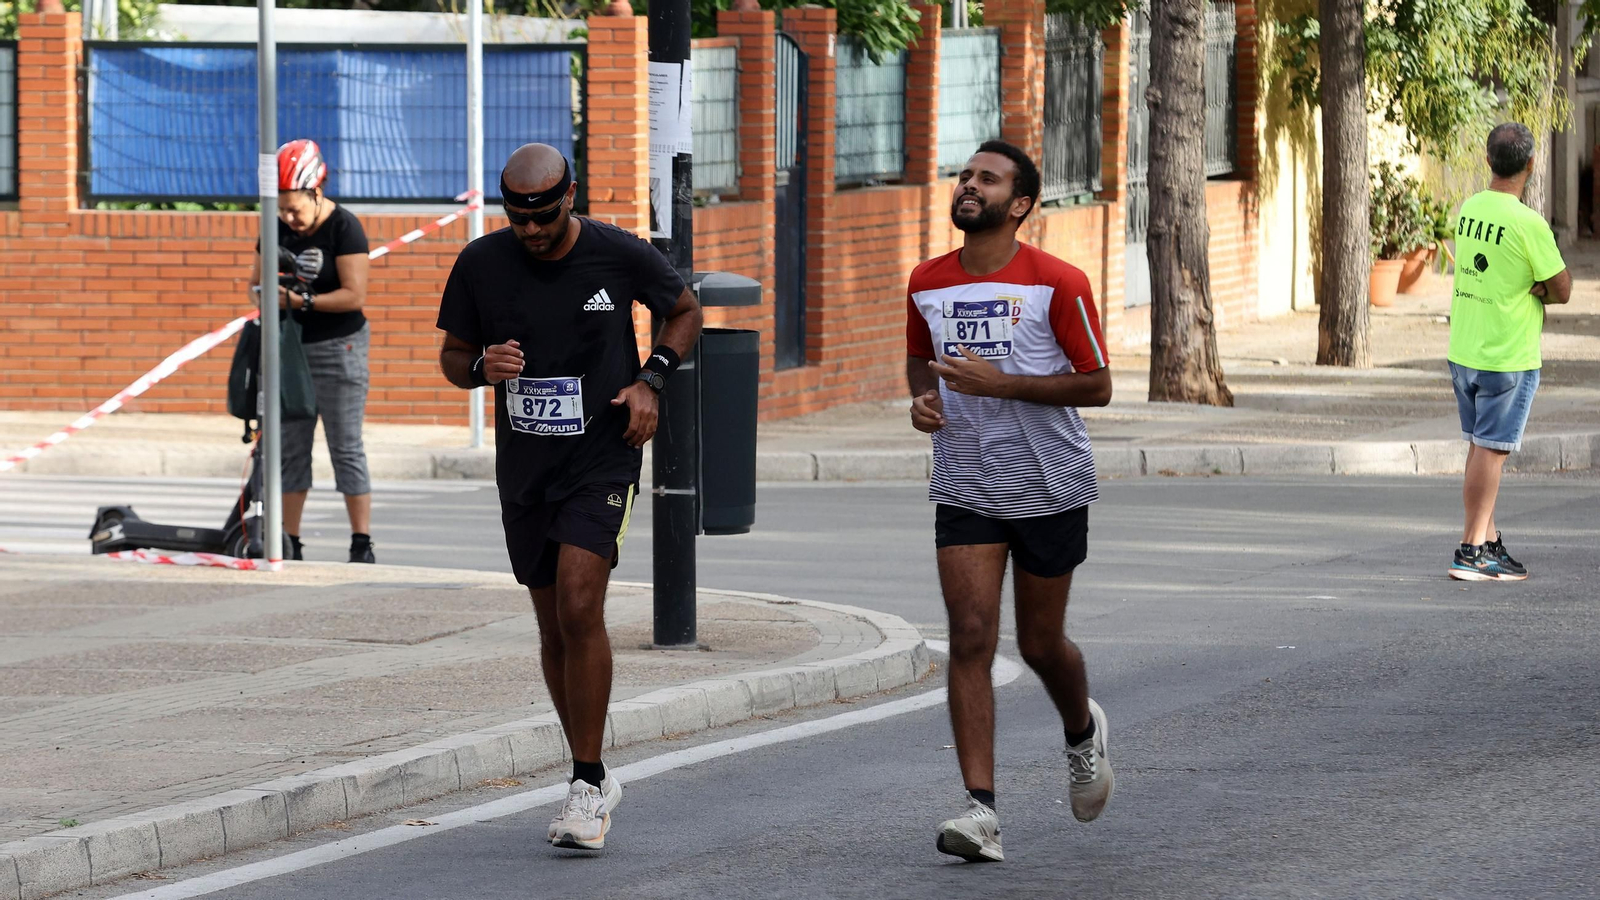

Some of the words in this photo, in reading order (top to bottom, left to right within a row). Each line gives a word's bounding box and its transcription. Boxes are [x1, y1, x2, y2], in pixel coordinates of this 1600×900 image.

[1458, 216, 1505, 245] STAFF
[583, 302, 615, 311] adidas
[956, 320, 991, 340] 871
[522, 397, 562, 418] 872
